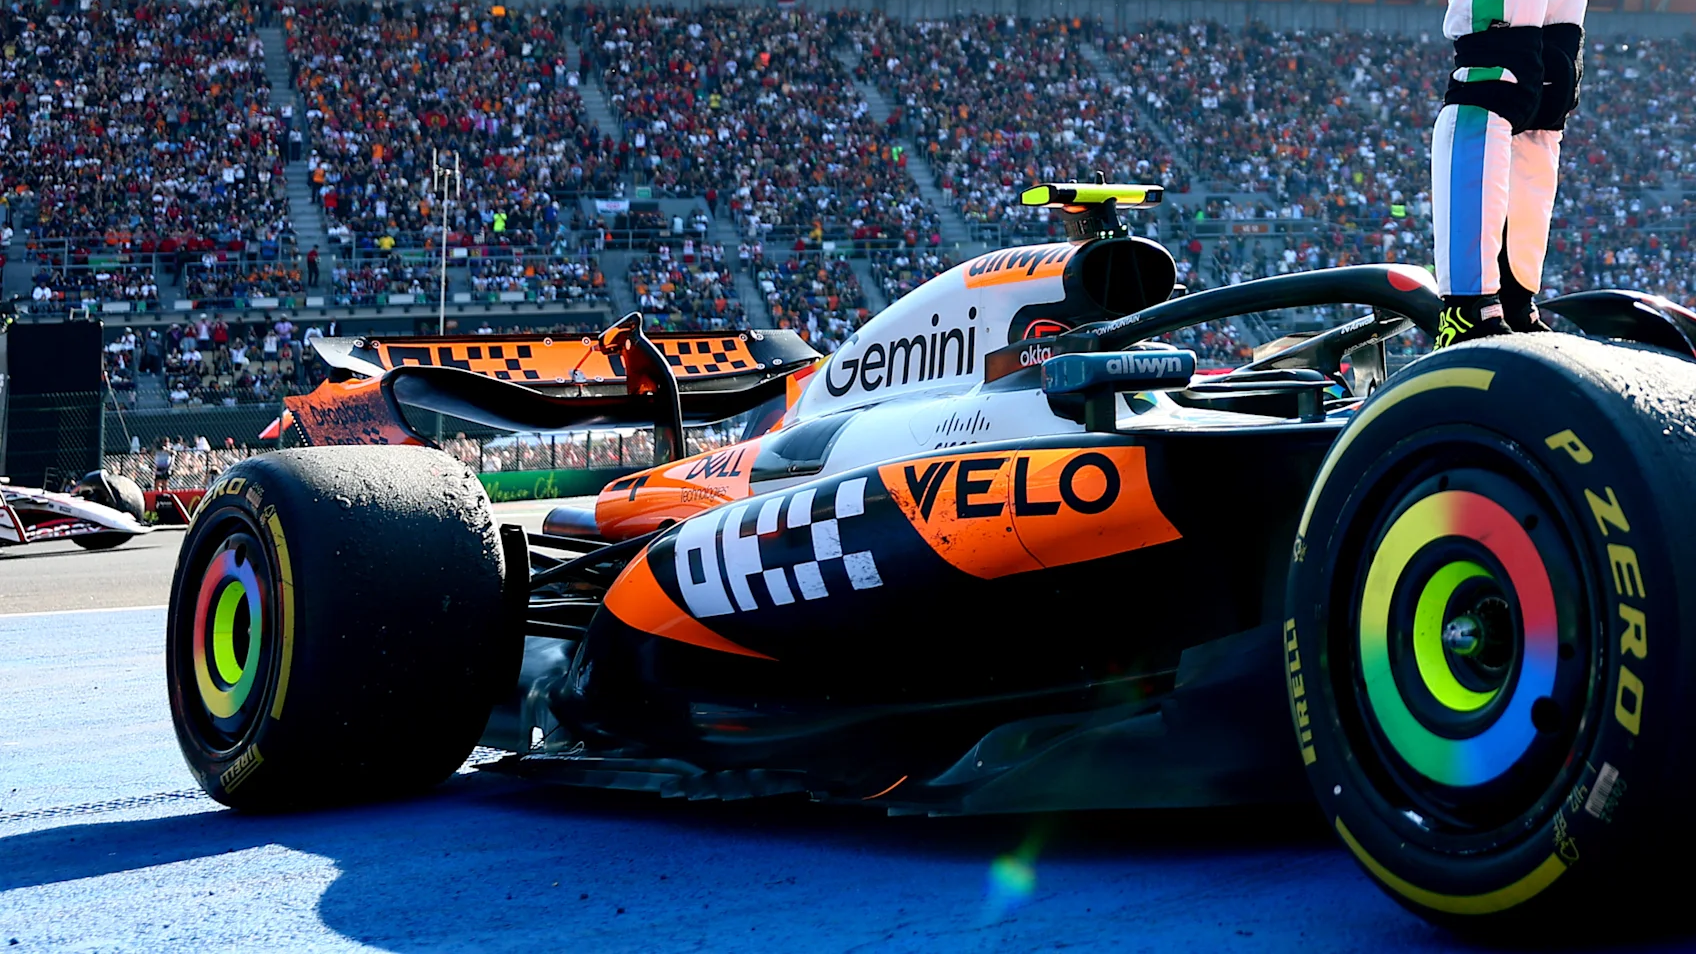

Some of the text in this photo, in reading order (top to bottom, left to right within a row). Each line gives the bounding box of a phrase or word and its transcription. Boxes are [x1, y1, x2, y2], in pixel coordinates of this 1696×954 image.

[825, 306, 978, 398] Gemini
[1019, 343, 1052, 368] okta
[1106, 353, 1183, 378] allwyn
[685, 448, 746, 480] DELL
[903, 451, 1121, 525] VELO
[1544, 429, 1594, 464] P
[1583, 486, 1648, 736] ZERO
